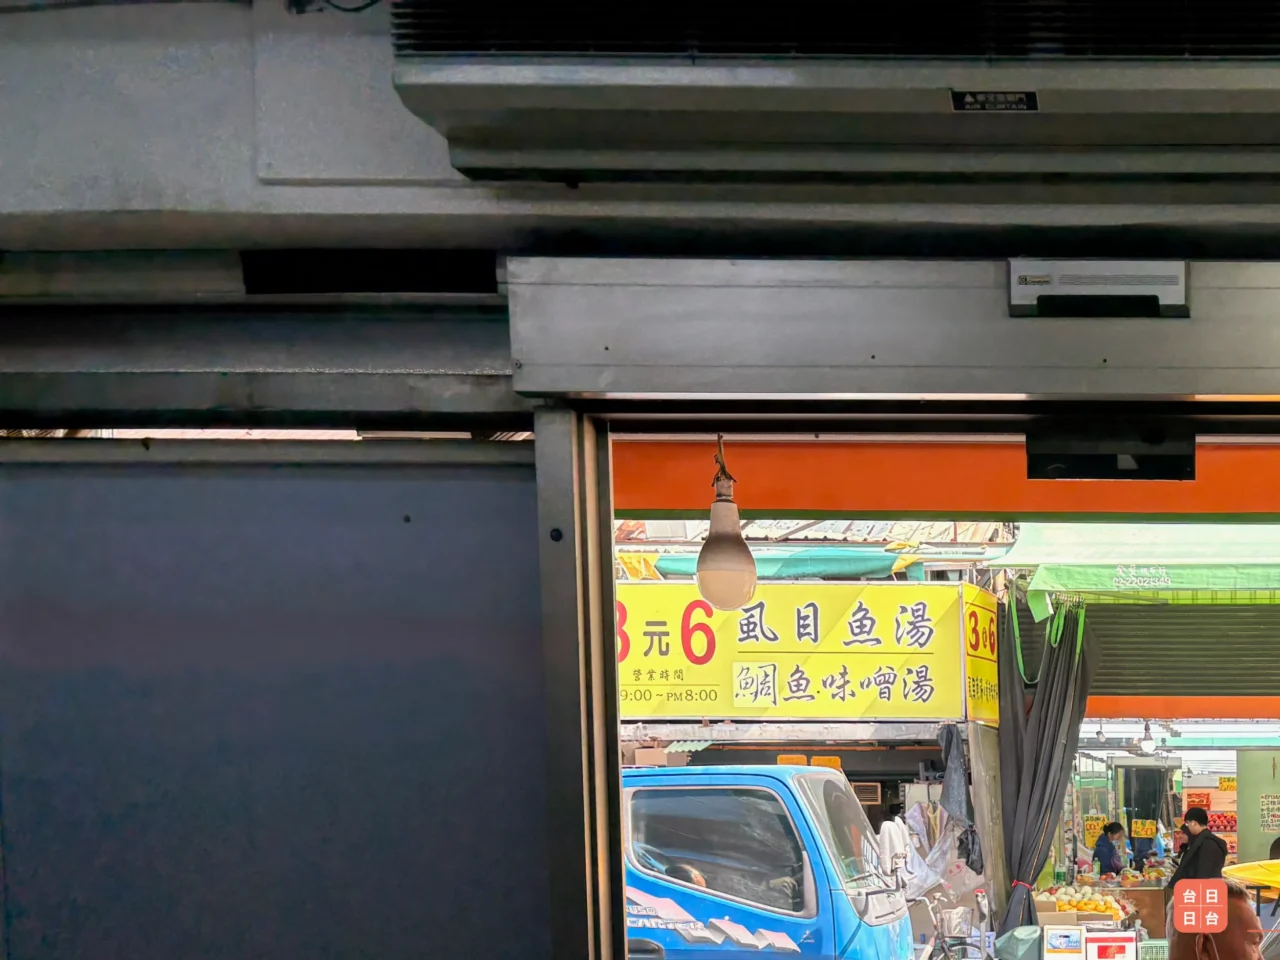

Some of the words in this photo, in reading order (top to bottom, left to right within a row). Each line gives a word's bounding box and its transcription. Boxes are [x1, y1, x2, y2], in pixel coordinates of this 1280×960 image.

[738, 601, 934, 648] 虱目魚湯
[633, 669, 684, 681] 營業時間
